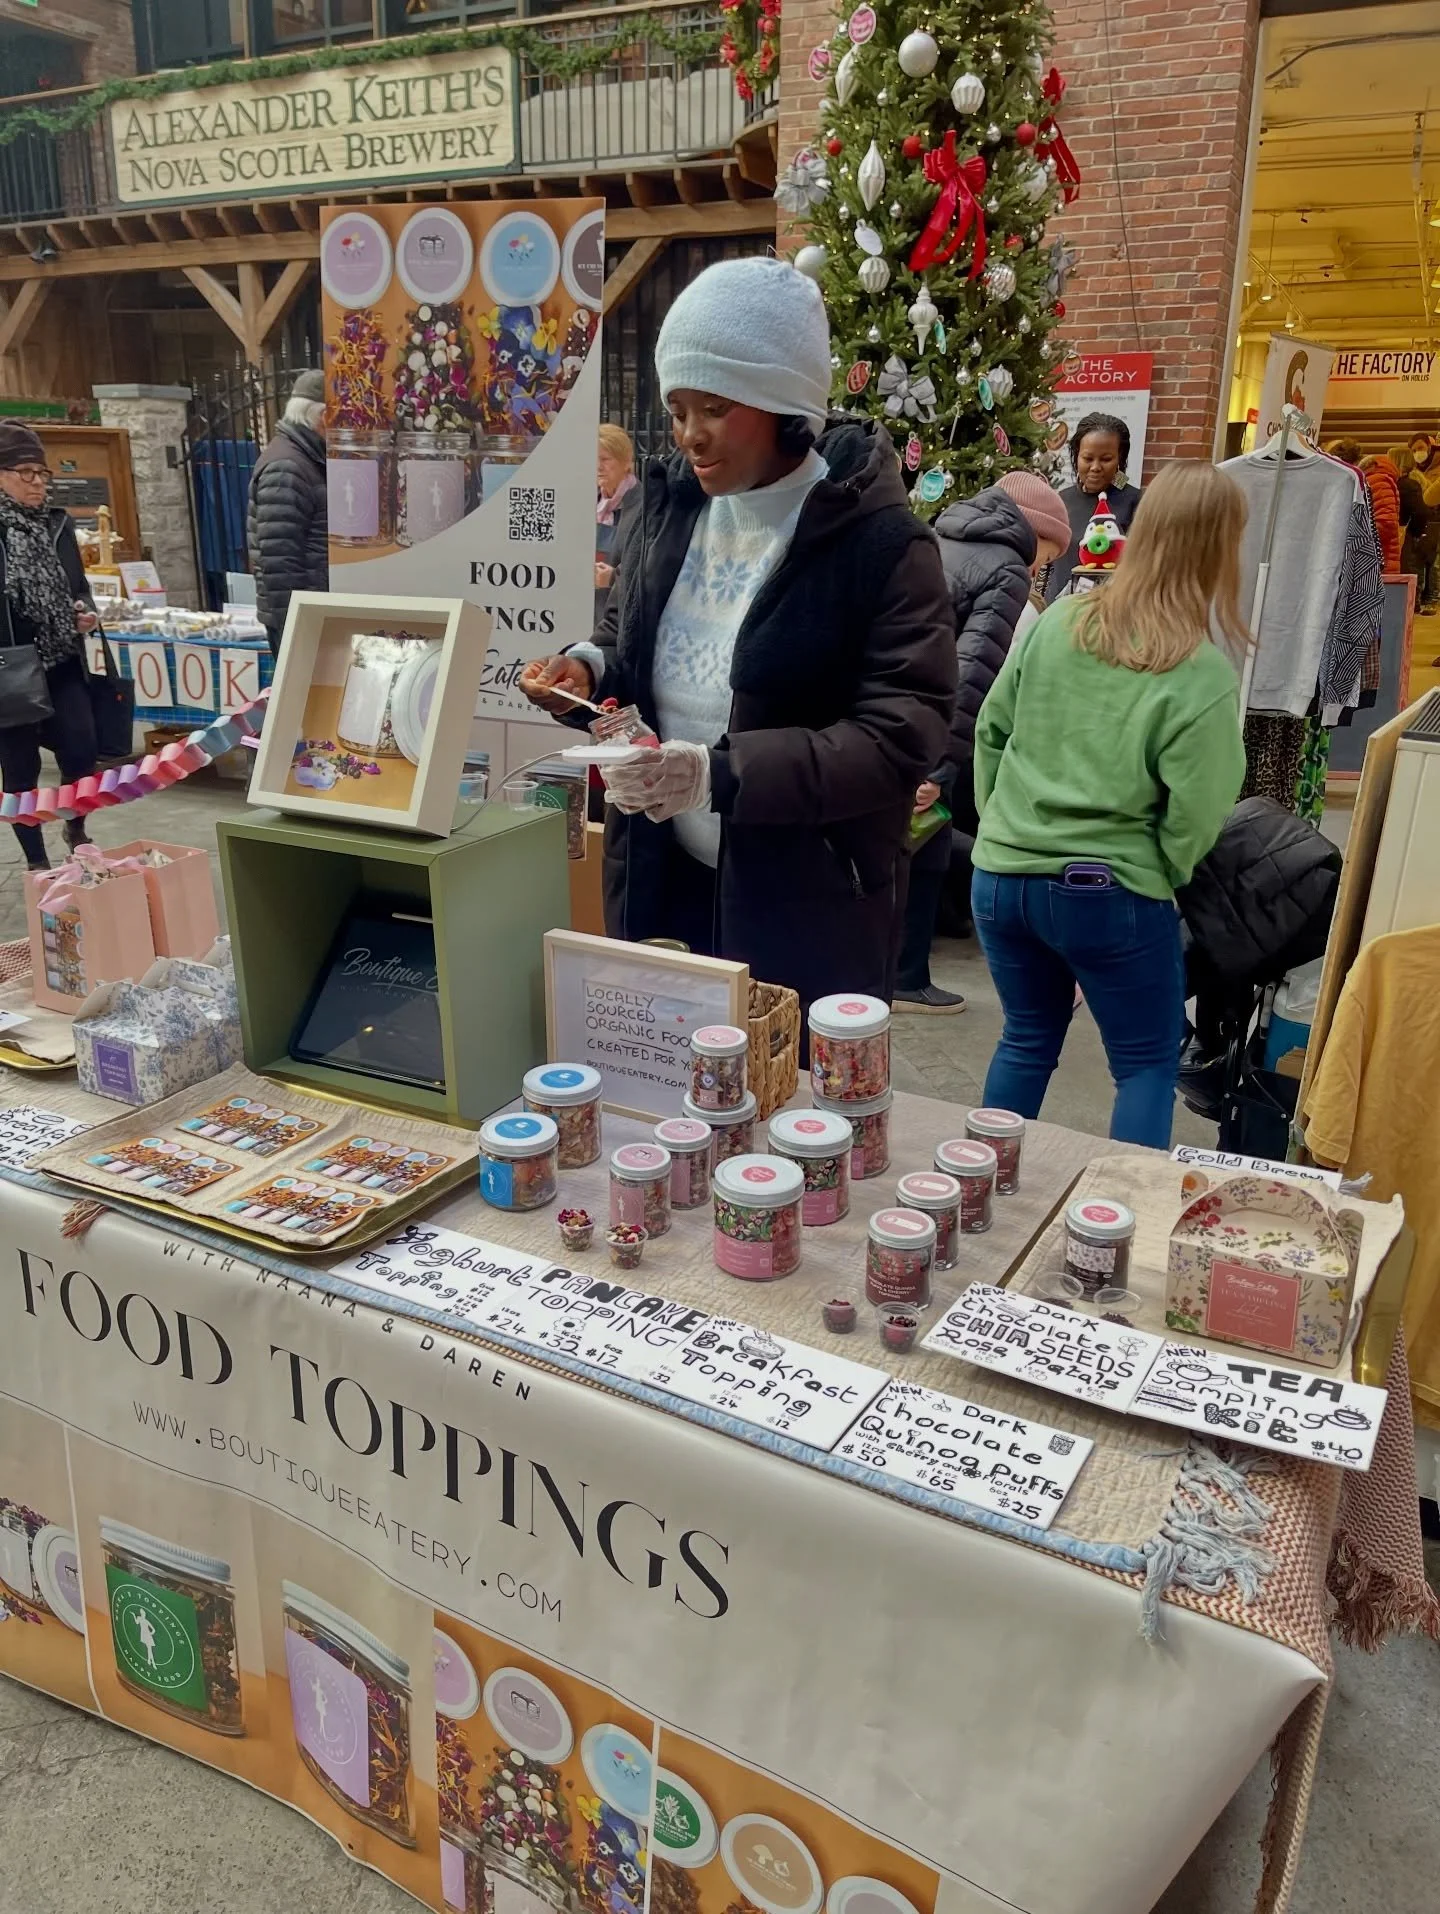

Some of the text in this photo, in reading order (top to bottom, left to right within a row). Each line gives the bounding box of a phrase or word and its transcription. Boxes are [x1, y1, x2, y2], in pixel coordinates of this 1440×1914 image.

[122, 65, 504, 152] ALEXANDER KEITH'S
[129, 124, 499, 192] NOVA SCOTIA BREWERY
[1064, 371, 1137, 385] ACTORY
[1081, 360, 1113, 371] THE
[1362, 352, 1436, 374] FACTORY
[469, 561, 556, 589] FOOD
[341, 947, 425, 989] Boutique
[586, 986, 654, 1008] LOCALLY
[586, 1001, 655, 1023] SOURCED
[586, 1016, 691, 1048] ORGANIC FOO
[587, 1039, 650, 1060] CREATED
[655, 1053, 676, 1066] FOR
[1177, 1147, 1324, 1181] Cold Brew
[356, 1251, 458, 1299] Topping
[970, 1287, 1006, 1296] NEW
[529, 1285, 678, 1347] TOPPING
[541, 1268, 709, 1334] PANCAKE
[1030, 1304, 1100, 1332] Dark
[162, 1240, 531, 1400] WITH NAANA & DAREN
[961, 1298, 1111, 1353] Chocolate
[946, 1311, 1136, 1378] CHIA SEEDS
[1165, 1348, 1207, 1358] NEW
[889, 1385, 922, 1396] NEW
[1227, 1363, 1344, 1403] TEA
[1152, 1370, 1327, 1431] Sampling
[16, 1248, 731, 1620] FOOD TOPPINGS
[875, 1397, 1042, 1465] Chocolate
[963, 1405, 1028, 1436] Dark
[855, 1429, 880, 1444] with
[942, 1462, 962, 1473] and
[1311, 1440, 1362, 1459] $40
[133, 1400, 563, 1623] WWW.BOUTIQUEEATERY.COM
[997, 1497, 1042, 1520] $25
